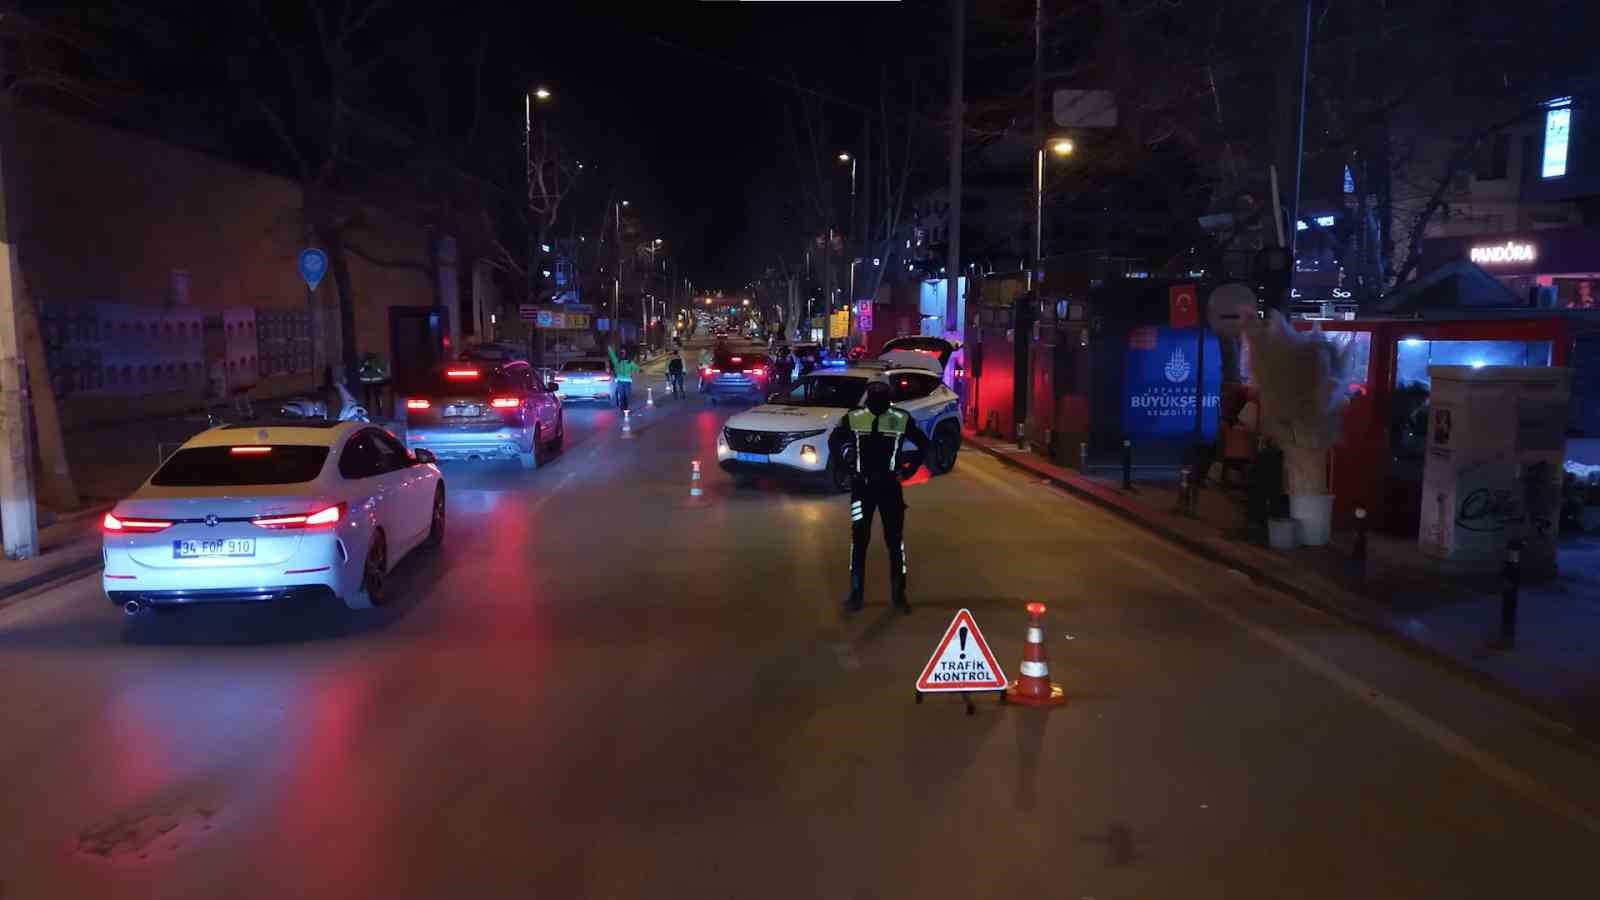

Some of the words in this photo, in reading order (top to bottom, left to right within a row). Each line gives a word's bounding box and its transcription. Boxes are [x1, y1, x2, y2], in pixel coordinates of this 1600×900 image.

[182, 541, 196, 554] 34
[228, 540, 250, 553] 910
[940, 659, 985, 671] TRAFİK
[934, 671, 993, 682] KONTROL
